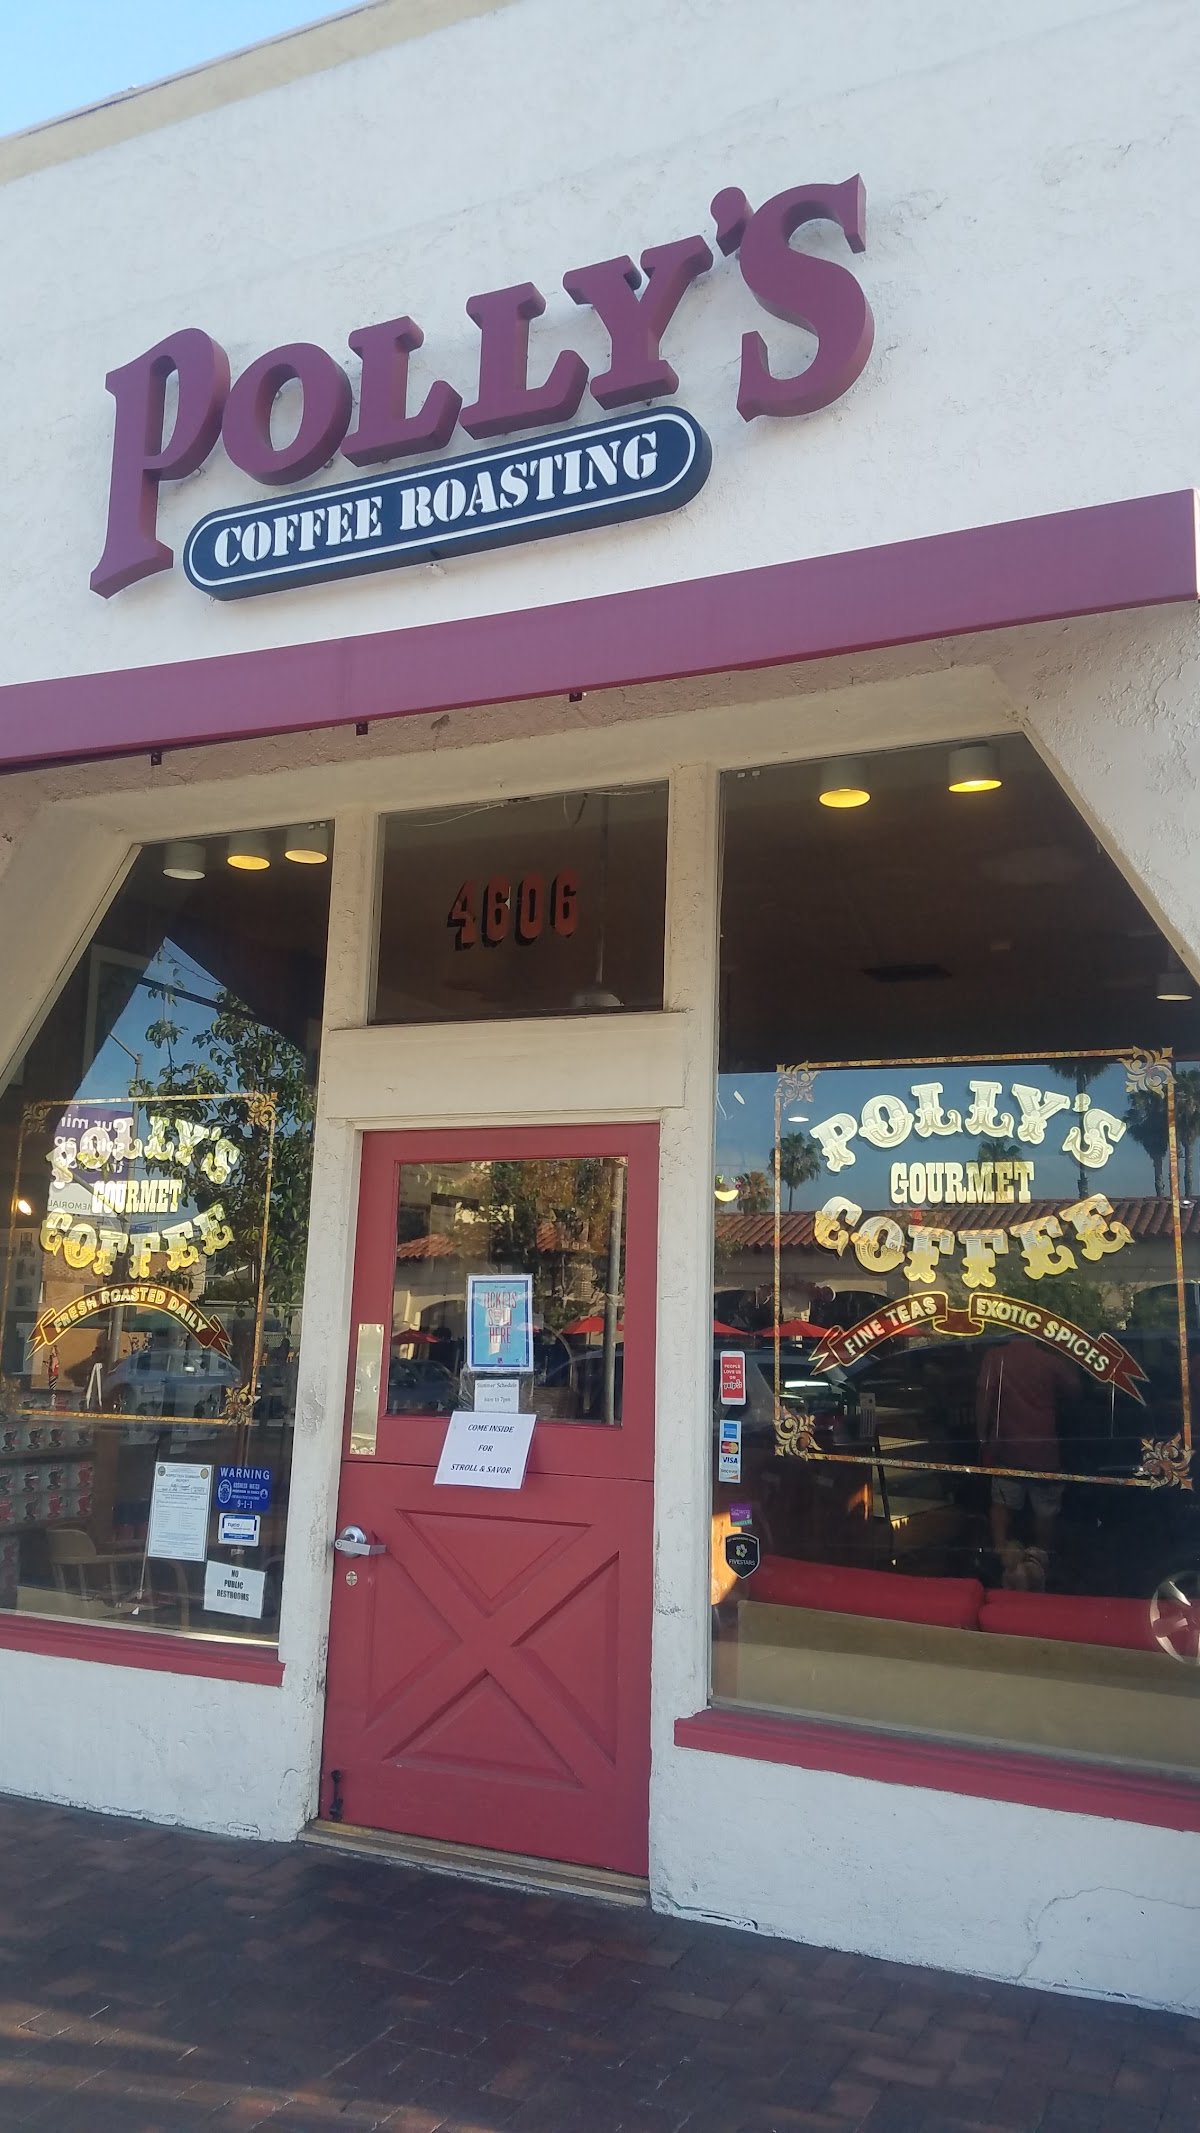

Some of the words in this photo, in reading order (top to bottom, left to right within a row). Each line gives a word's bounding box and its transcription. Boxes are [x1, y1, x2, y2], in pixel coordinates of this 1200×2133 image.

[90, 174, 874, 599] POLLY'S
[213, 495, 383, 568] COFFEE
[399, 431, 659, 533] ROASTING
[448, 868, 578, 948] 4606
[809, 1080, 1127, 1172] POLLY'S
[46, 1115, 241, 1189] POLLY'S
[92, 1179, 182, 1214] GOURMET
[890, 1161, 1036, 1205] GOURMET
[40, 1203, 235, 1279] COFFEE
[813, 1193, 1136, 1289] COFFEE
[53, 1295, 98, 1333] FRESH
[101, 1286, 166, 1305] ROASTED
[167, 1296, 208, 1333] DAILY
[481, 1291, 517, 1309] TICKETS
[489, 1327, 511, 1344] HERE
[844, 1318, 886, 1357] FINE
[885, 1296, 937, 1327] TEAS
[976, 1298, 1042, 1330] EXOTIC
[1042, 1320, 1110, 1373] SPICES
[468, 1423, 489, 1432] COME
[488, 1424, 515, 1433] INSIDE
[478, 1444, 494, 1452] FOR
[723, 1456, 738, 1464] VISA
[220, 1467, 270, 1480] WARNING
[450, 1463, 478, 1472] STROLL
[486, 1465, 512, 1474] SAVOR
[224, 1579, 244, 1590] PUBLIC
[231, 1569, 240, 1578] NO
[216, 1589, 250, 1601] RESTROOMS
